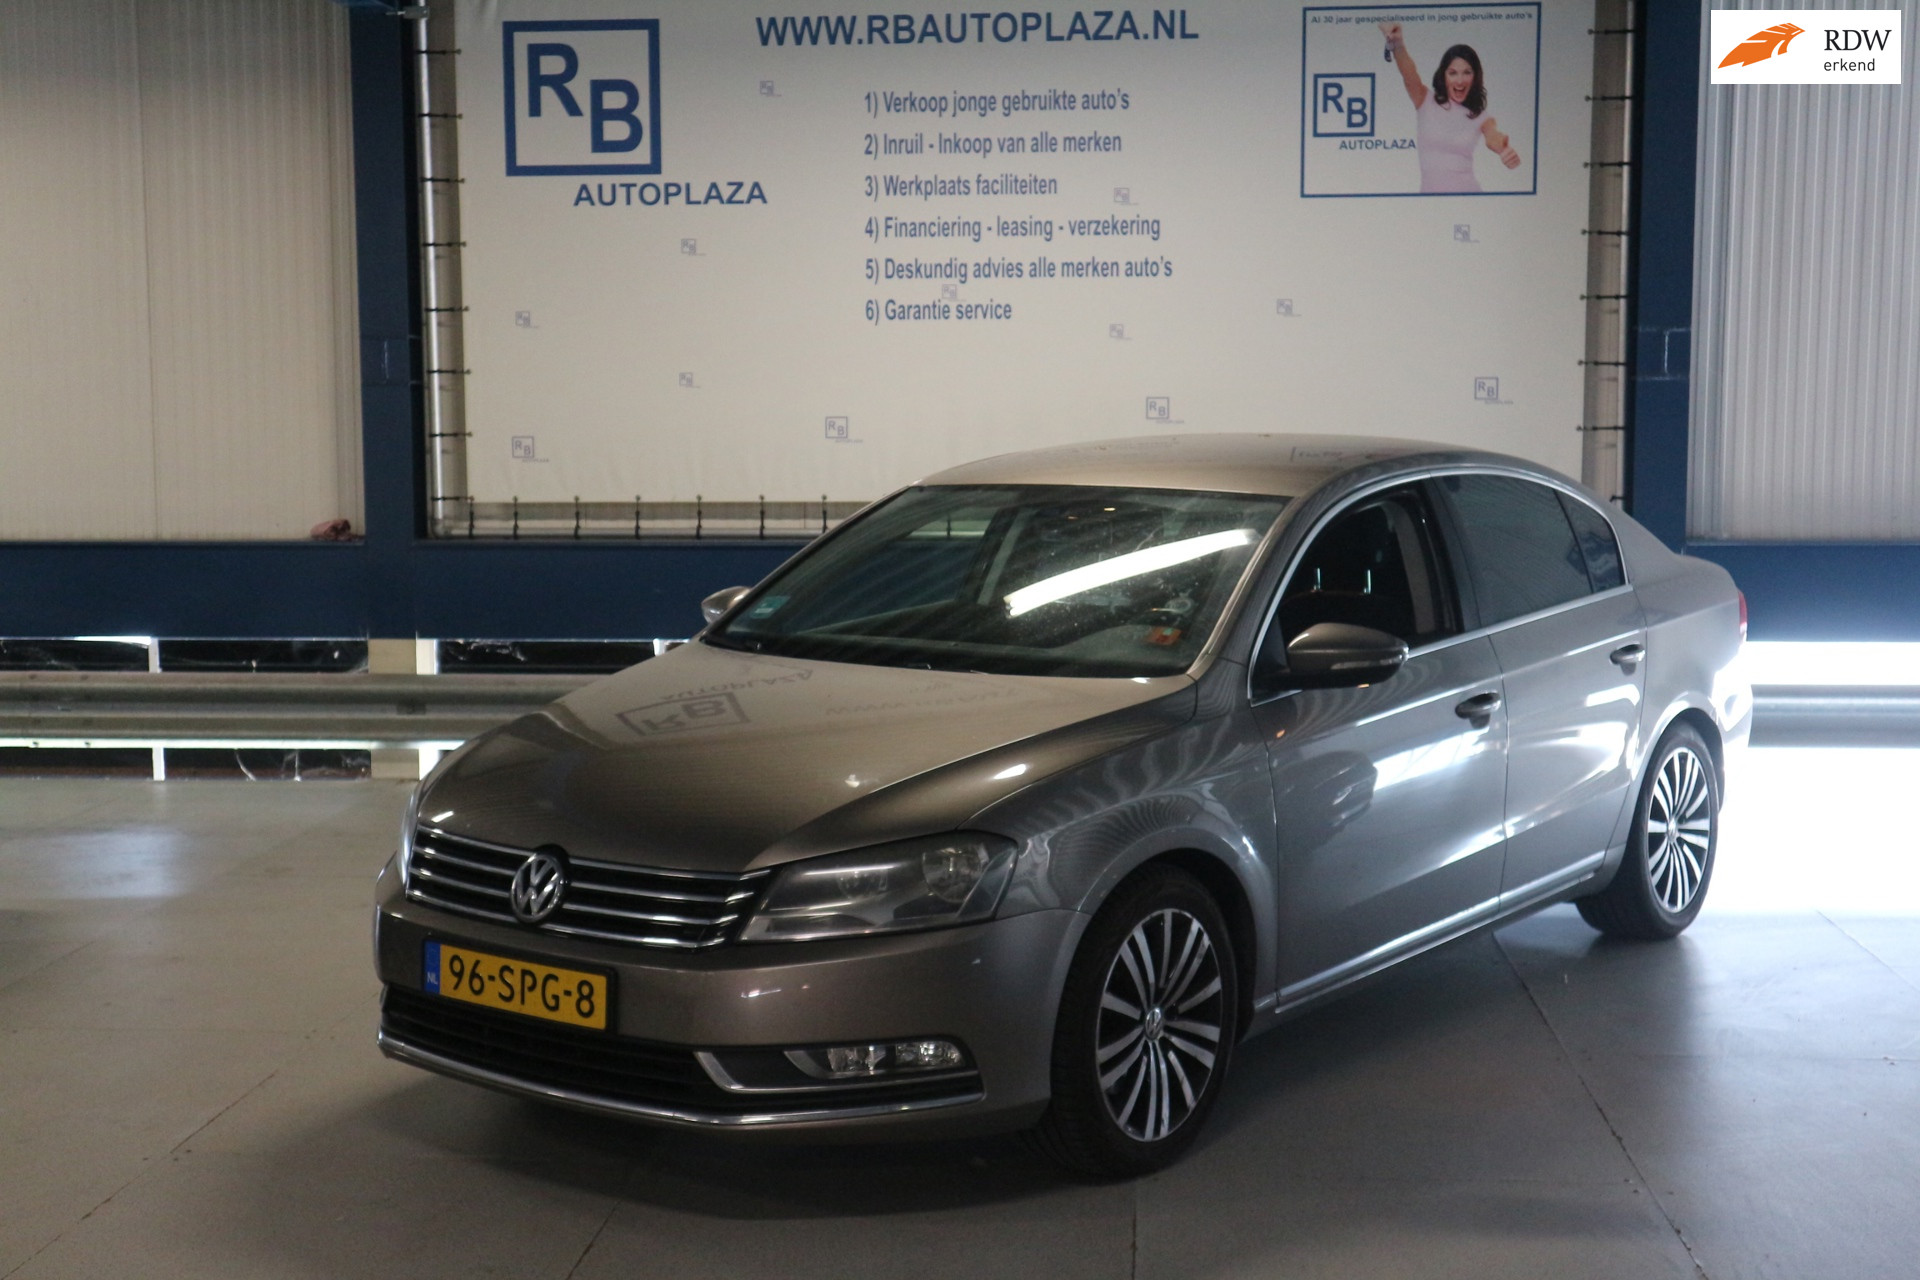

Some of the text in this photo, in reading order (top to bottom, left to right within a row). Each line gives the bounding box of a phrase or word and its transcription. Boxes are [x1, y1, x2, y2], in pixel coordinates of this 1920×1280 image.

[756, 9, 1199, 46] WWW.RBAUTOPLAZA.NL
[1323, 15, 1334, 24] 30
[1335, 15, 1352, 25] jaar
[1355, 14, 1425, 25] gespecialiseerd
[1427, 13, 1436, 21] in
[1437, 13, 1459, 23] jong
[1460, 12, 1503, 22] gebruikte
[1505, 12, 1533, 20] auto's
[527, 43, 644, 153] RB
[864, 88, 1130, 119] 1) Verkoop jonge gebruikte auto's
[1322, 82, 1369, 128] RB
[864, 134, 879, 160] 2)
[883, 133, 923, 155] Inruil
[939, 133, 993, 159] Inkoop
[997, 137, 1025, 153] van
[1030, 131, 1058, 153] alle
[1063, 131, 1122, 153] merken
[1339, 139, 1417, 151] AUTOPLAZA
[573, 181, 768, 207] AUTOPLAZA
[864, 174, 1058, 202] 3) Werkplaats faciliteiten
[864, 217, 879, 243] 4)
[884, 216, 982, 243] Financiering
[997, 215, 1053, 243] leasing
[1068, 214, 1161, 241] verzekering
[865, 256, 1173, 285] 5) Deskundig advies alle merken auto's
[865, 298, 1012, 326] 6) Garantie service
[511, 852, 564, 923] VW
[427, 972, 438, 985] NL
[449, 954, 595, 1018] 96-SPG-8
